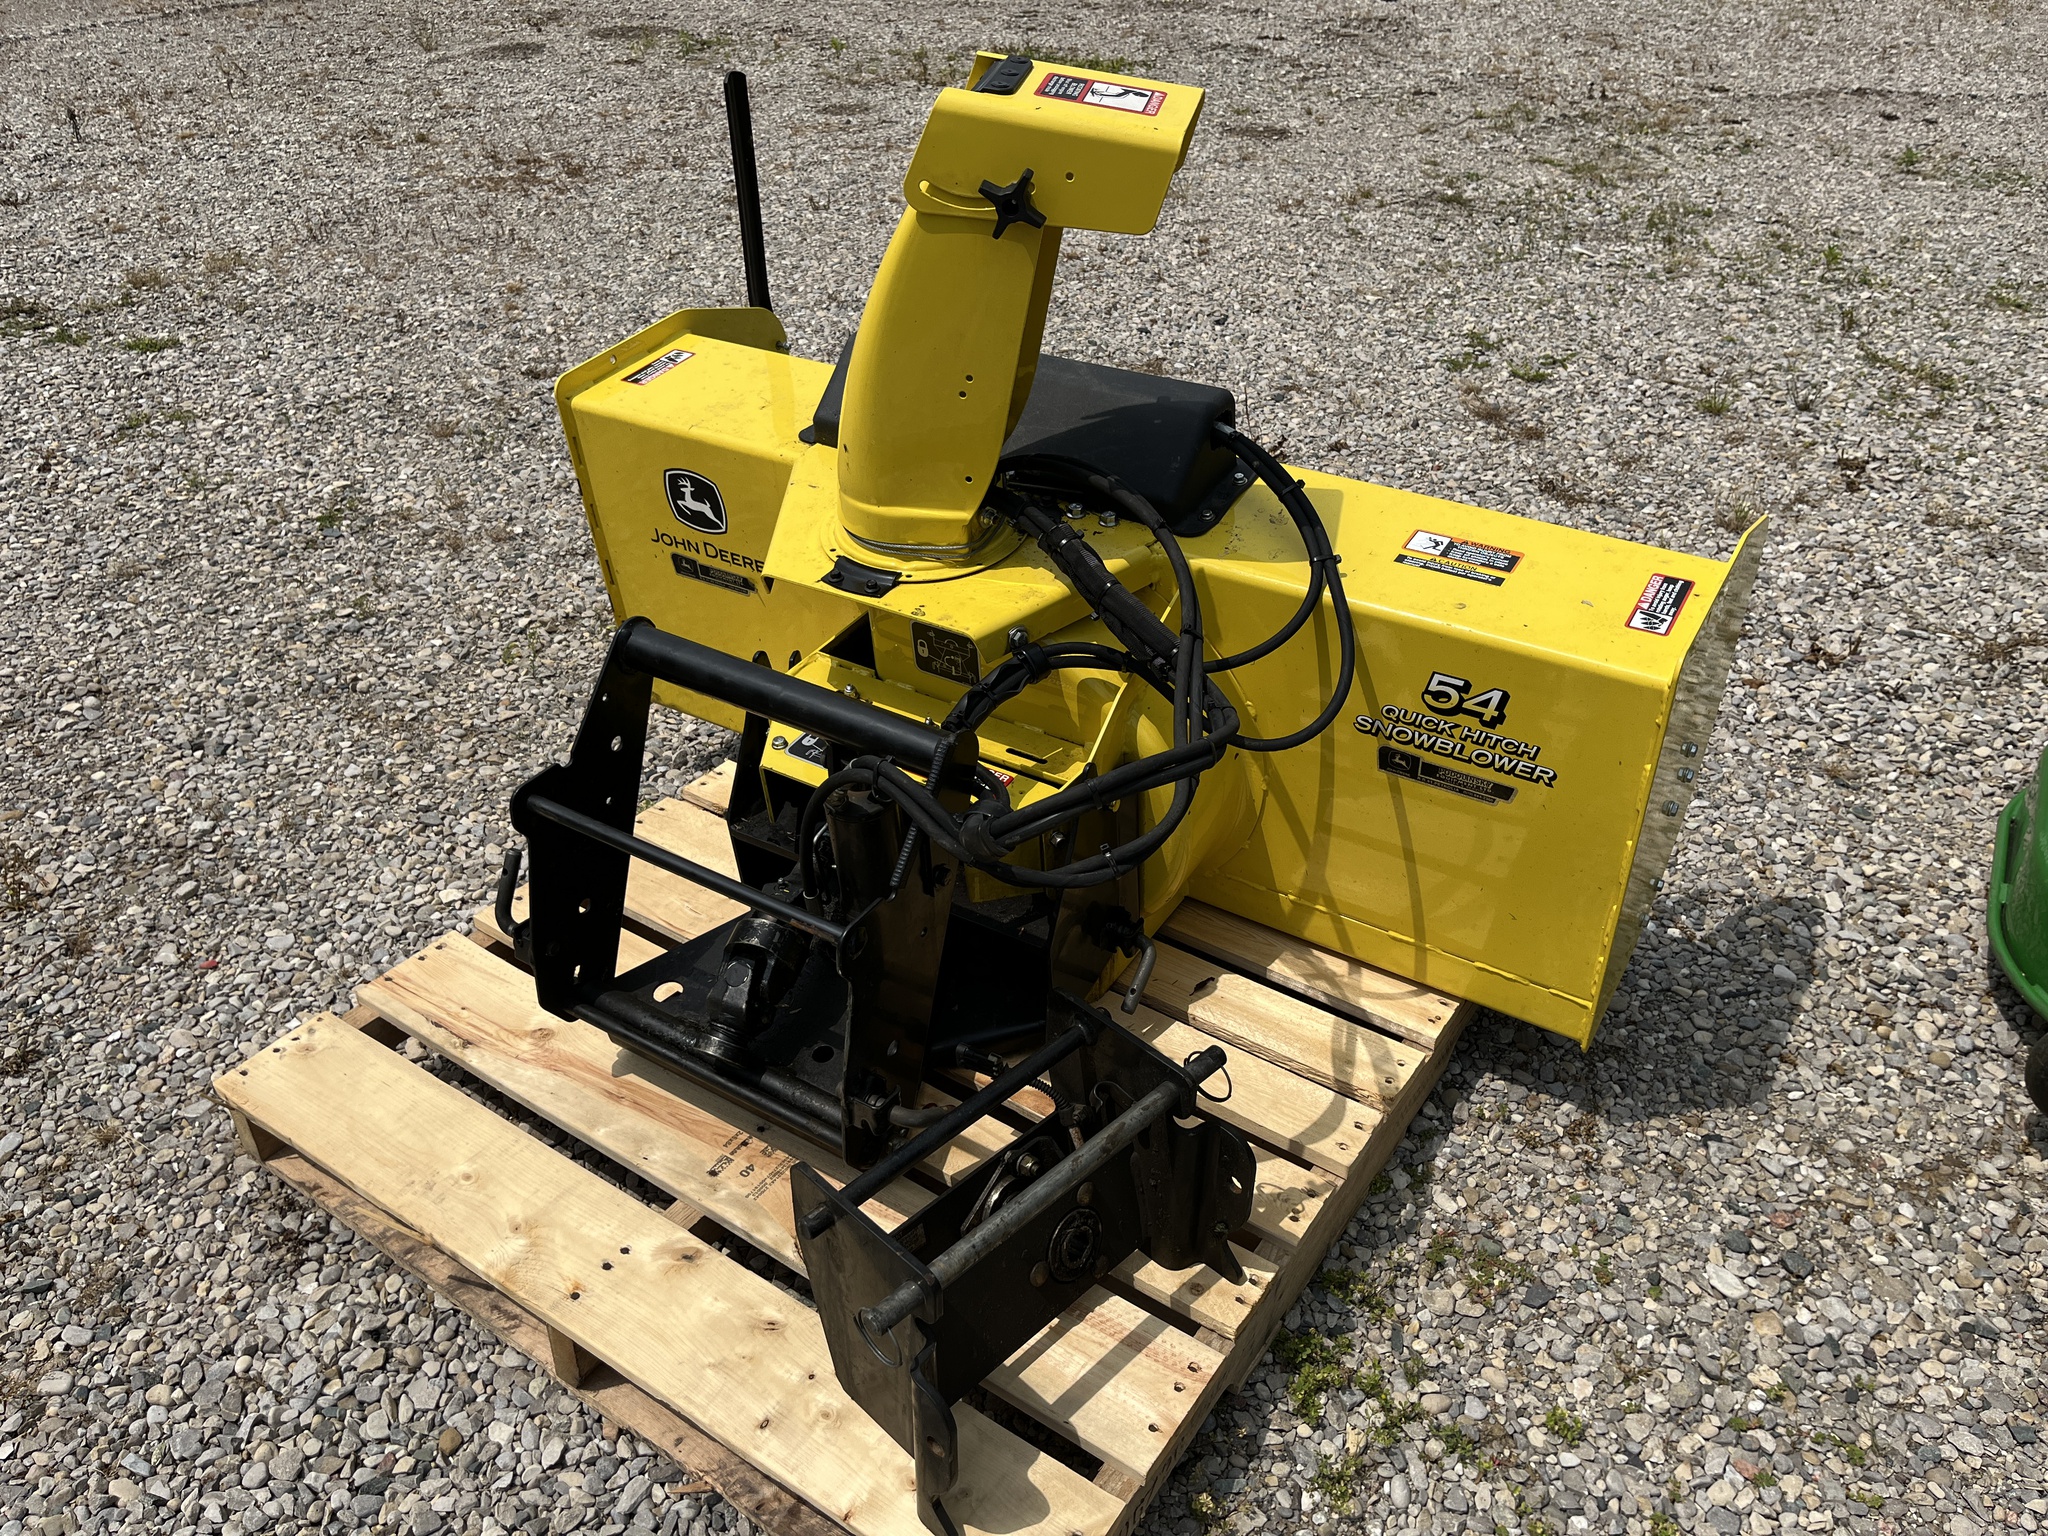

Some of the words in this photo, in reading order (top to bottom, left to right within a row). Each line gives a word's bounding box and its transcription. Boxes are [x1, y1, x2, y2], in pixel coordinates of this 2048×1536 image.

[651, 528, 700, 554] JOHN
[703, 541, 764, 573] DEERE
[1438, 559, 1477, 571] CAUTION
[1471, 541, 1511, 554] WARNING
[1640, 575, 1665, 602] DANGER
[1422, 671, 1511, 729] 54
[1381, 705, 1461, 738] QUICK
[1460, 726, 1541, 760] HITCH
[1353, 715, 1558, 788] SNOWBLOWER
[739, 1164, 755, 1178] 40
